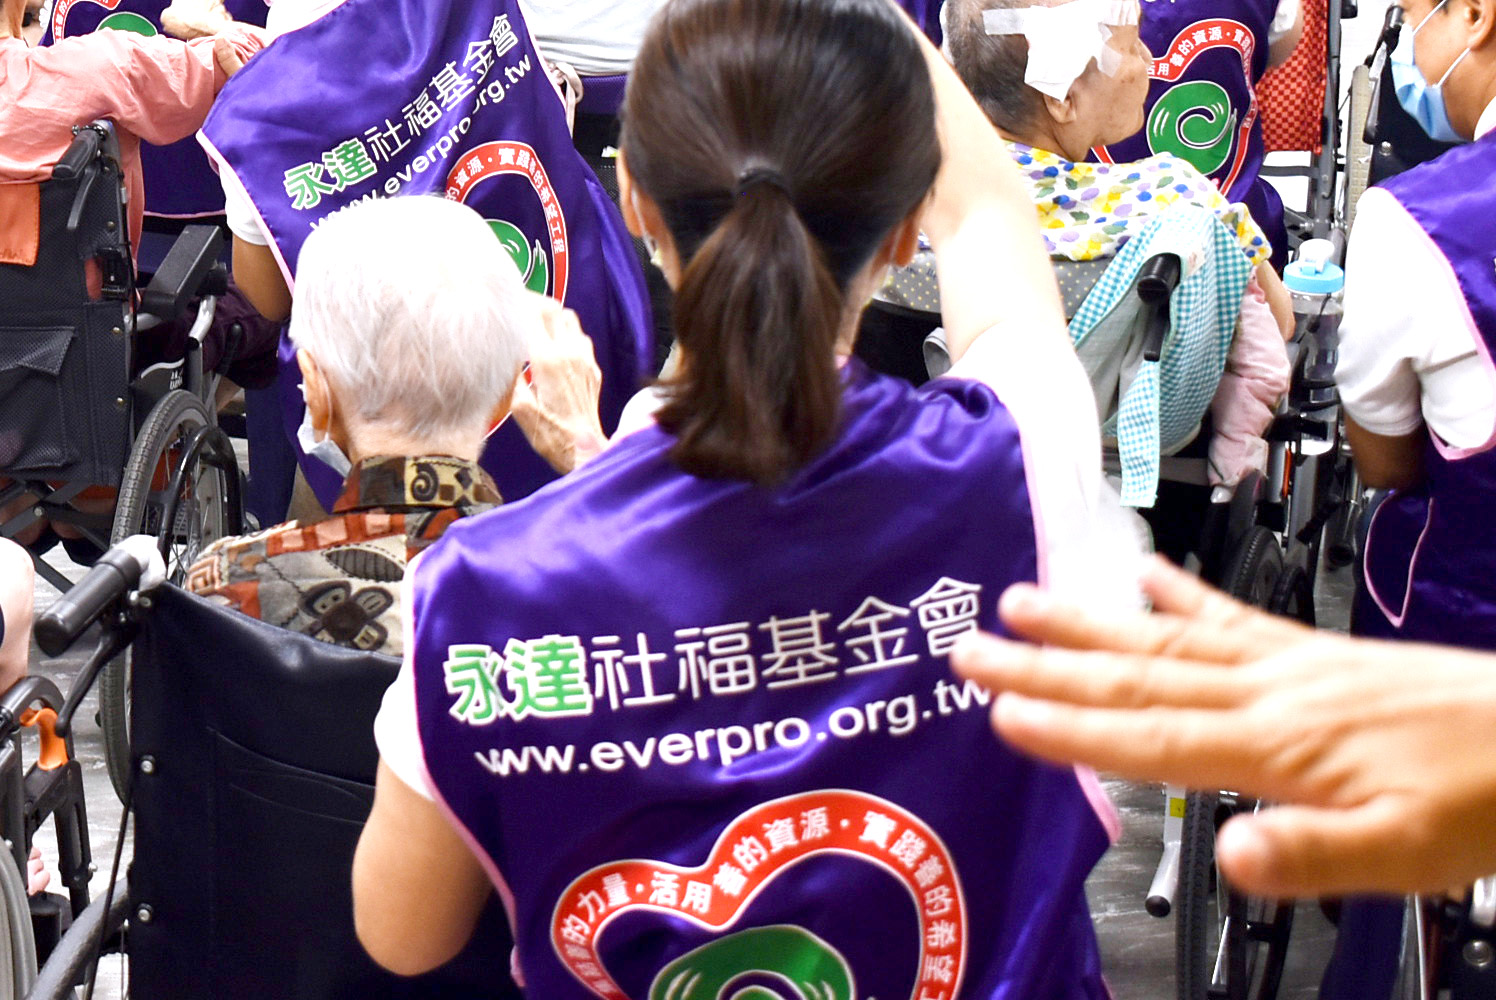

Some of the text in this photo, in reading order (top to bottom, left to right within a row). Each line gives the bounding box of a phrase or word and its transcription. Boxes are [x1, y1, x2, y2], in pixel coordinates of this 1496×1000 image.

[283, 13, 519, 211] 永達社福基金會
[444, 576, 982, 725] 永達社福基金會
[474, 679, 991, 775] www.everpro.org.tw
